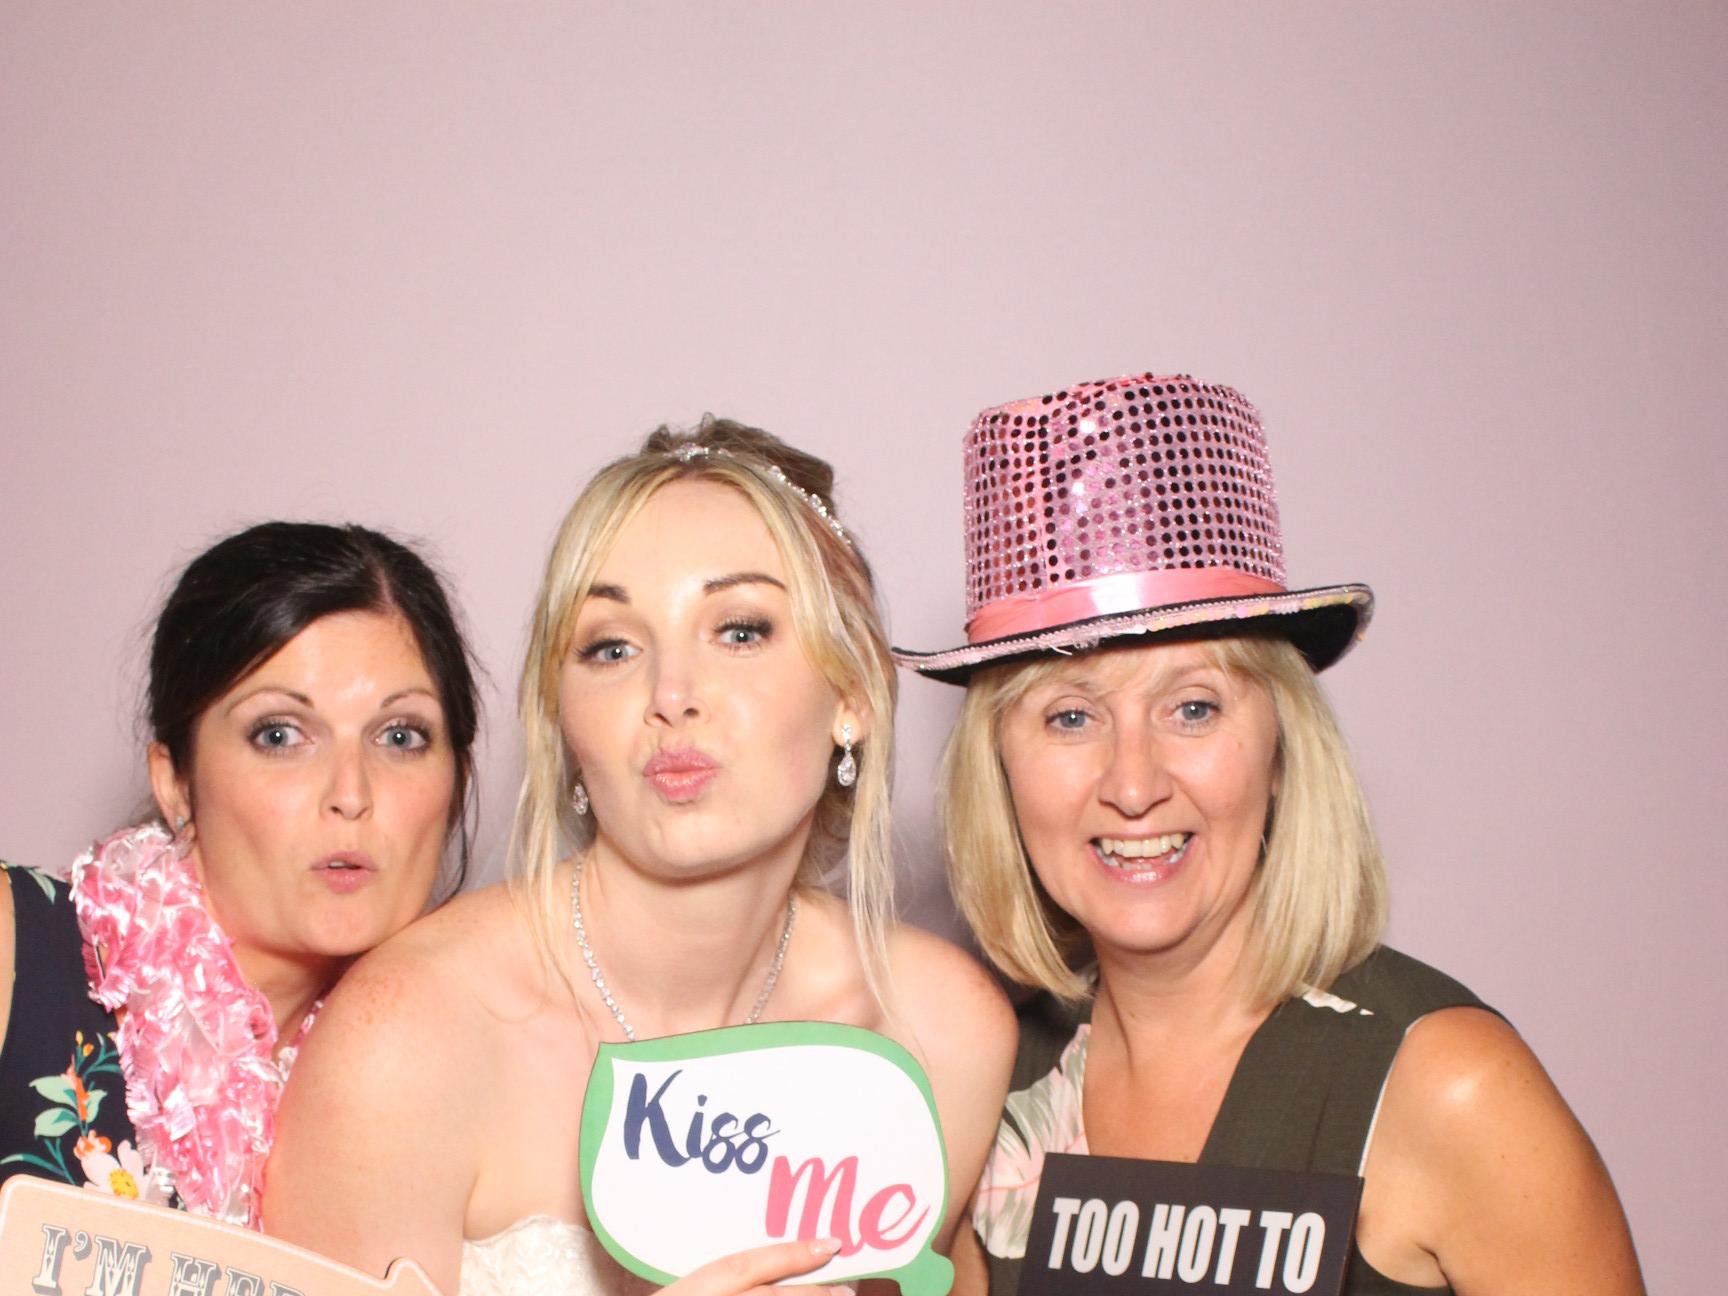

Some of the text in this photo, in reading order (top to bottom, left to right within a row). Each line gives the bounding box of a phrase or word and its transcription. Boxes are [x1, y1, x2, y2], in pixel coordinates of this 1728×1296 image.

[623, 1069, 780, 1174] Kiss
[1048, 1197, 1326, 1294] TOO HOT TO
